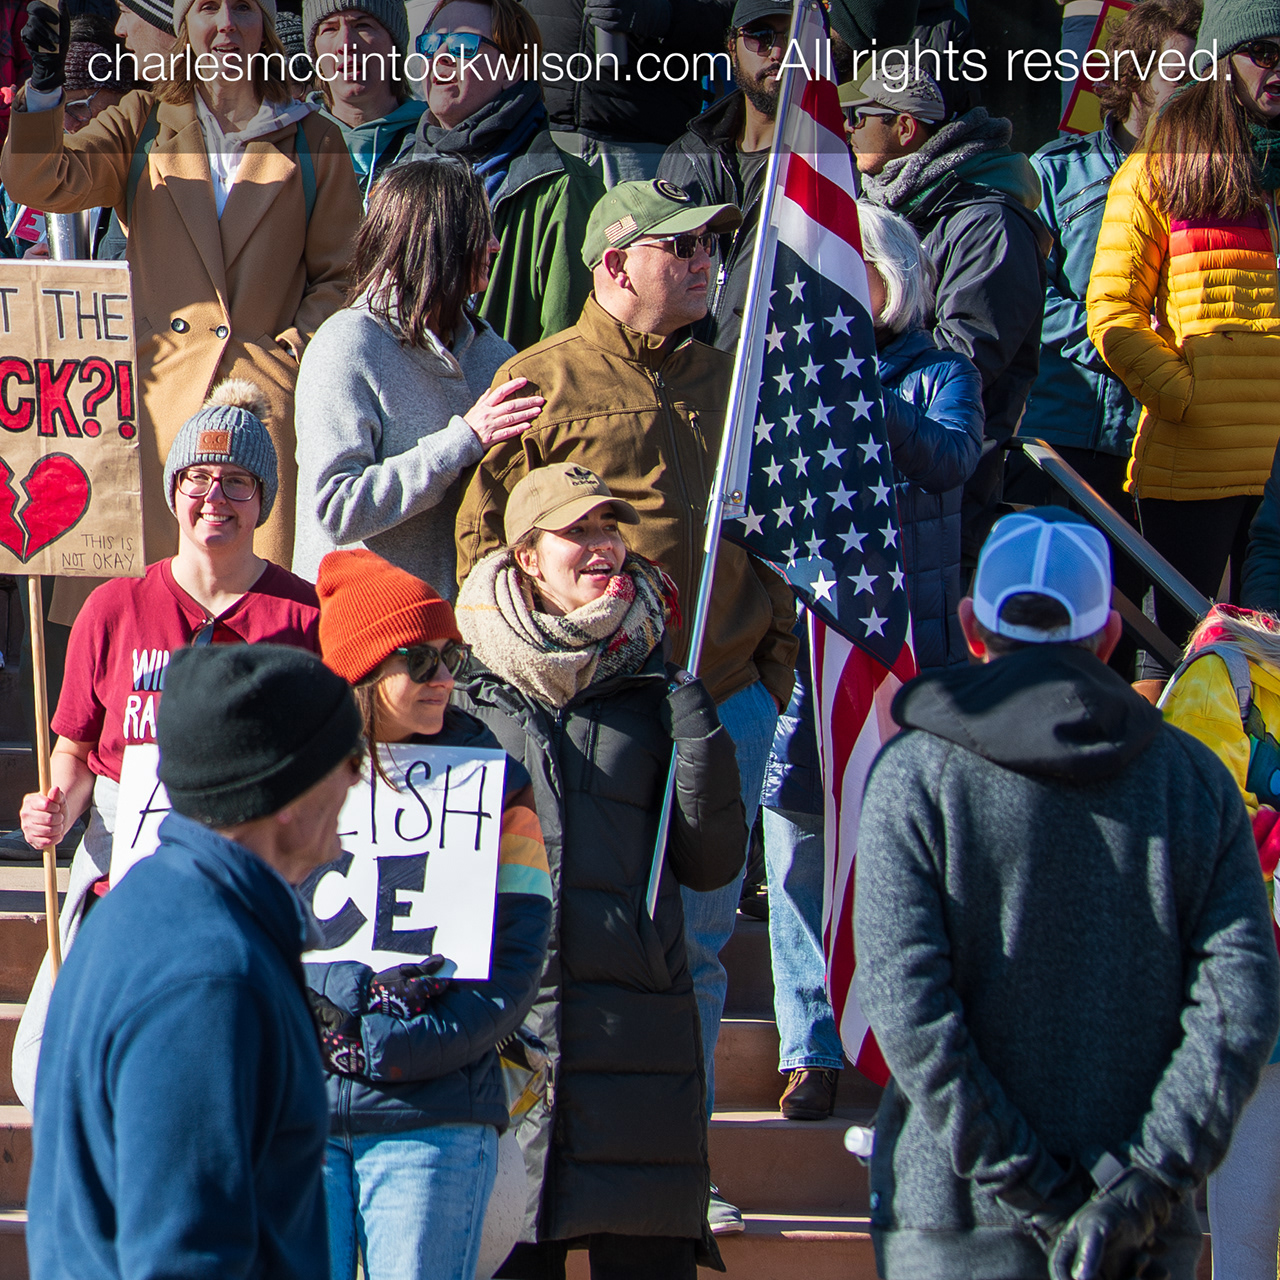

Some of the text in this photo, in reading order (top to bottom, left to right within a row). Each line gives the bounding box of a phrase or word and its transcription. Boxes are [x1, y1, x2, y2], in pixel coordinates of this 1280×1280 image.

[43, 288, 132, 342] THE
[81, 533, 135, 551] THIS IS
[61, 552, 135, 571] NOT OKAY
[297, 849, 438, 957] CE
